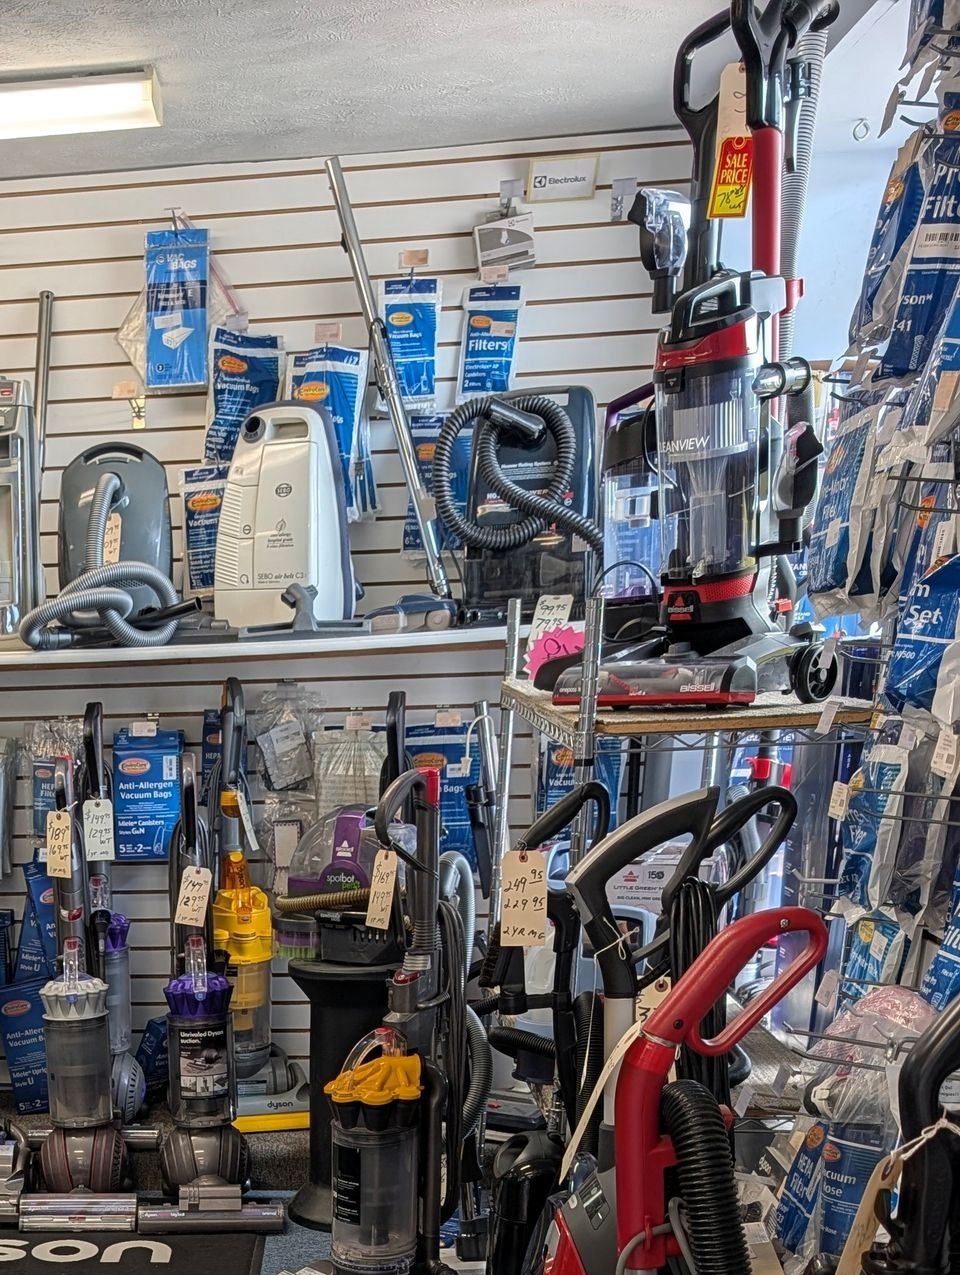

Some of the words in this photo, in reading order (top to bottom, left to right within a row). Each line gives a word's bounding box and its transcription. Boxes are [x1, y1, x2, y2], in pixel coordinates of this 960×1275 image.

[725, 153, 748, 168] SALE
[548, 175, 587, 185] Electrolux
[720, 169, 748, 184] PRICE
[468, 339, 508, 352] Filters
[258, 572, 273, 580] SEBO
[909, 605, 942, 625] Set
[680, 682, 716, 693] BISSELL
[118, 780, 174, 790] Anti-Allergen
[443, 783, 464, 794] Bags
[120, 791, 152, 800] Vacuum
[153, 790, 173, 800] Bags
[138, 819, 165, 827] Canisters
[326, 872, 355, 885] spotbot
[504, 876, 528, 893] 249
[504, 897, 528, 912] 229
[180, 1030, 206, 1040] Unrivaled
[207, 1029, 224, 1039] Dyson
[8, 1036, 37, 1048] Vacuum
[180, 1037, 202, 1046] suction.
[266, 1099, 294, 1109] dyson
[822, 1166, 857, 1186] acuum
